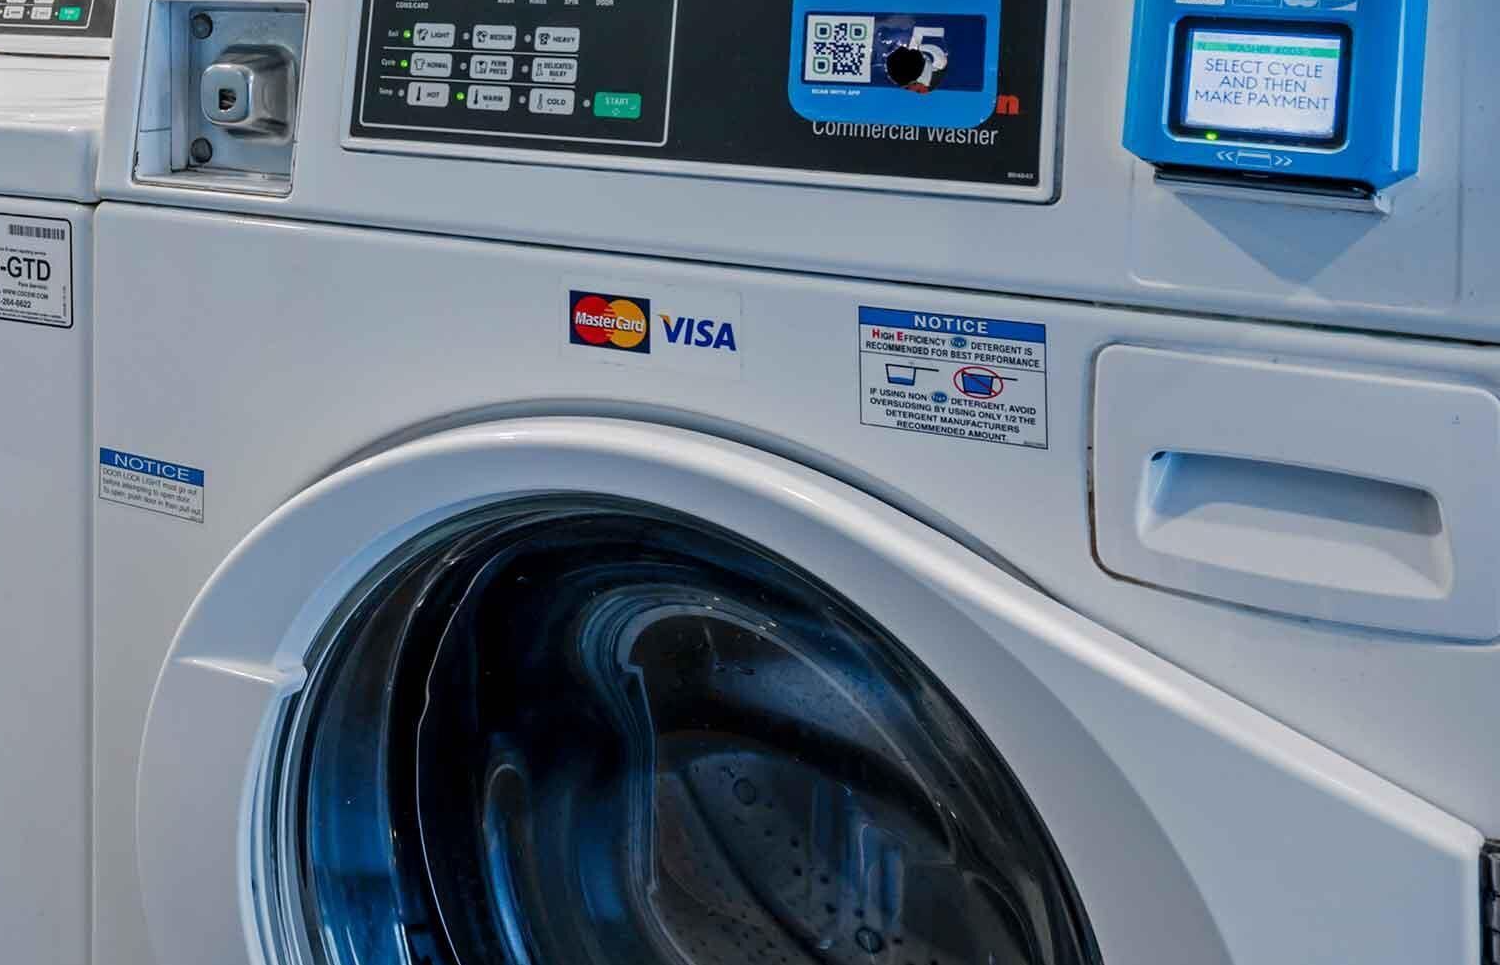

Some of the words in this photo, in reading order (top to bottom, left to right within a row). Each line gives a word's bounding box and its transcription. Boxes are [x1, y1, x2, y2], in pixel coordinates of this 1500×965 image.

[552, 35, 576, 45] HEAVY
[1204, 57, 1262, 75] SELECT
[1267, 61, 1324, 78] CYCLE
[1220, 76, 1258, 91] AND
[1263, 78, 1307, 93] THEN
[426, 90, 441, 100] HOT
[546, 97, 566, 107] COLD
[1194, 89, 1243, 106] MAKE
[1247, 92, 1331, 111] PAYMENT
[812, 121, 920, 141] Commercial
[575, 311, 645, 333] MasterCard
[658, 314, 737, 351] VISA
[913, 315, 989, 334] NOTICE
[866, 341, 930, 355] RECOMMENDED
[931, 348, 948, 358] FOR
[950, 350, 973, 360] BEST
[974, 352, 1040, 368] PERFORMANCE
[971, 341, 1022, 355] DETERGENT
[1025, 347, 1033, 356] IS
[870, 388, 877, 396] IF
[879, 389, 906, 400] USING
[908, 392, 927, 402] NON
[1009, 404, 1037, 415] AVOID
[870, 397, 932, 412] OVERSUDSING
[934, 404, 946, 414] BY
[948, 407, 976, 418] USING
[978, 410, 1001, 421] ONLY
[1004, 414, 1017, 423] 1/2
[1019, 416, 1036, 425] THE
[885, 408, 937, 423] DETERGENT
[940, 416, 1020, 434] MANUFACTURERS
[896, 420, 966, 436] RECOMMENDED
[114, 453, 190, 482] NOTICE
